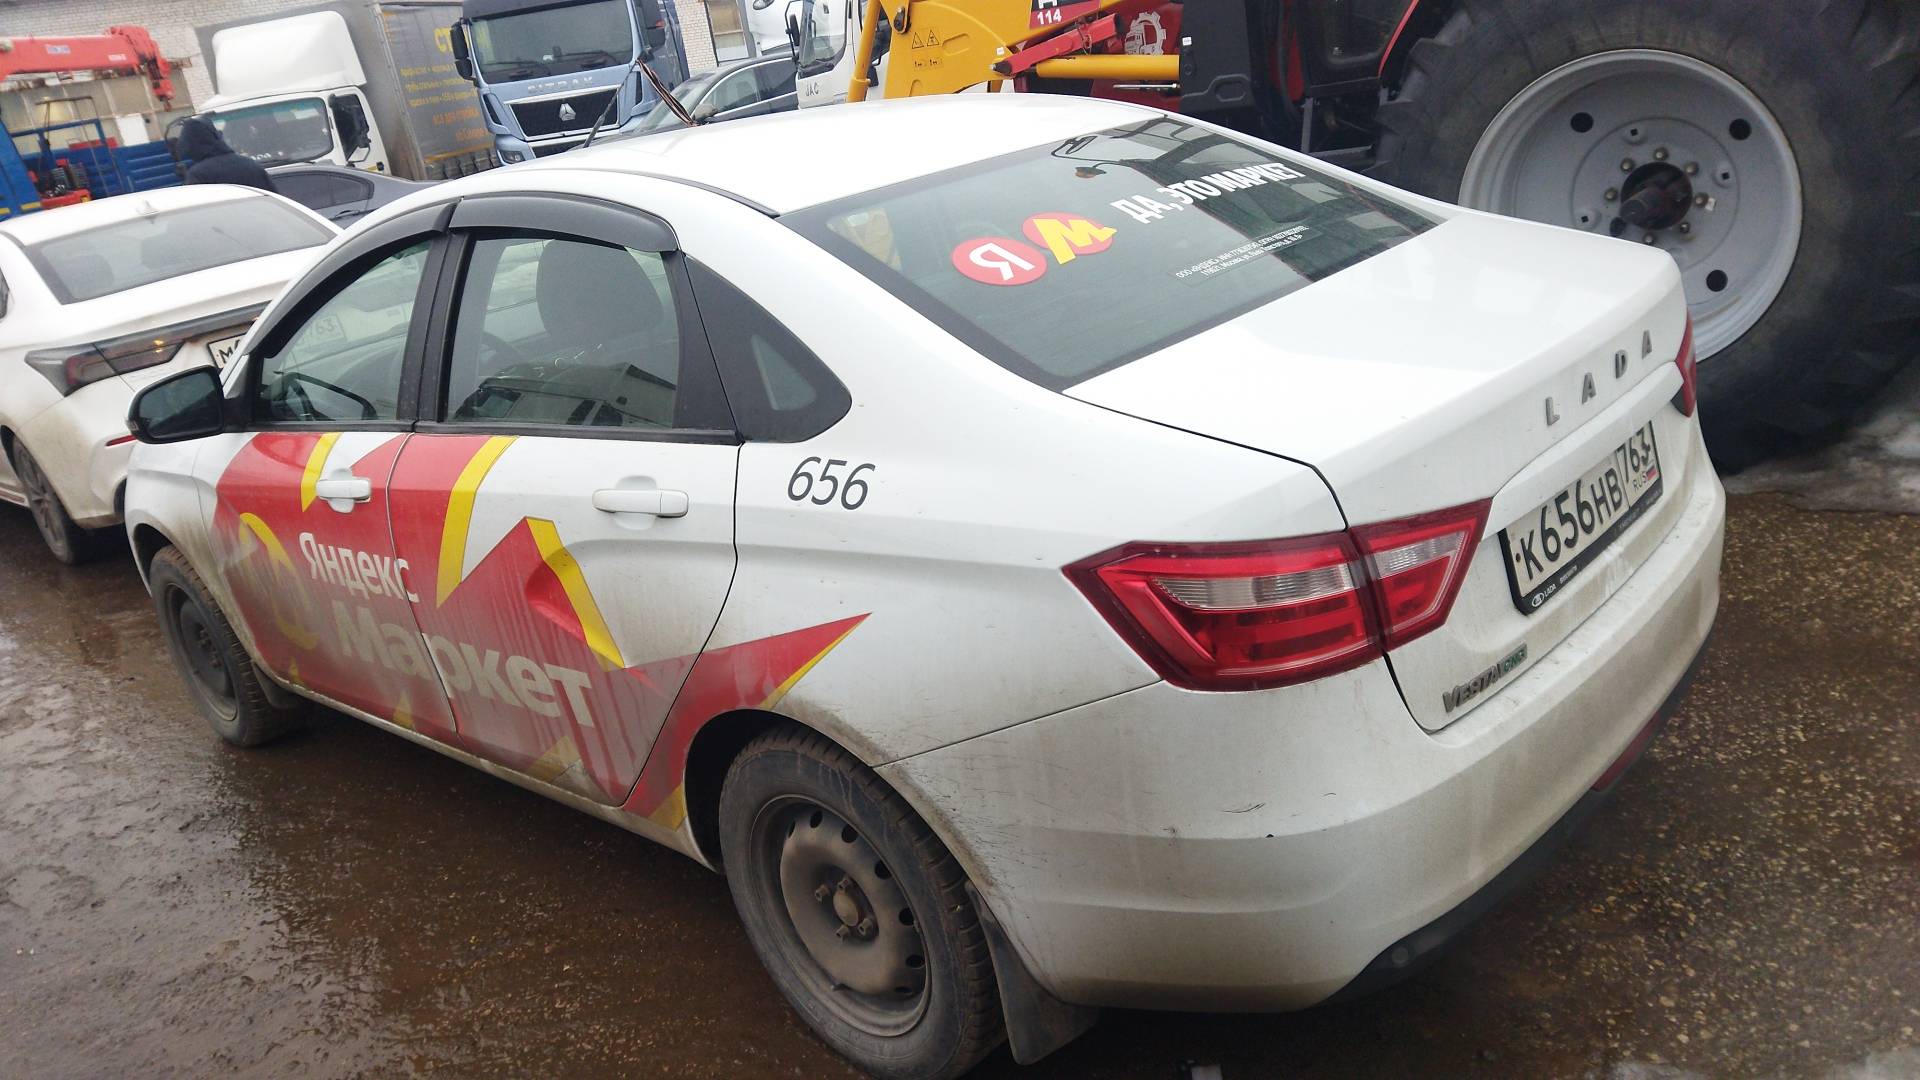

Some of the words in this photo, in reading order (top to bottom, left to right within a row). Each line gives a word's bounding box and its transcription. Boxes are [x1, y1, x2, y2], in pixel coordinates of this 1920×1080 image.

[1036, 8, 1063, 25] 114
[805, 82, 820, 97] JAC
[1201, 162, 1307, 193] МАРКЕТ
[968, 242, 1036, 281] Я
[1545, 329, 1653, 426] LADA
[1616, 430, 1652, 484] 763
[1632, 471, 1649, 493] RUS
[786, 455, 877, 511] 656
[299, 531, 420, 604] Яндекс
[331, 599, 595, 729] Маркет
[1441, 664, 1500, 714] VESTA
